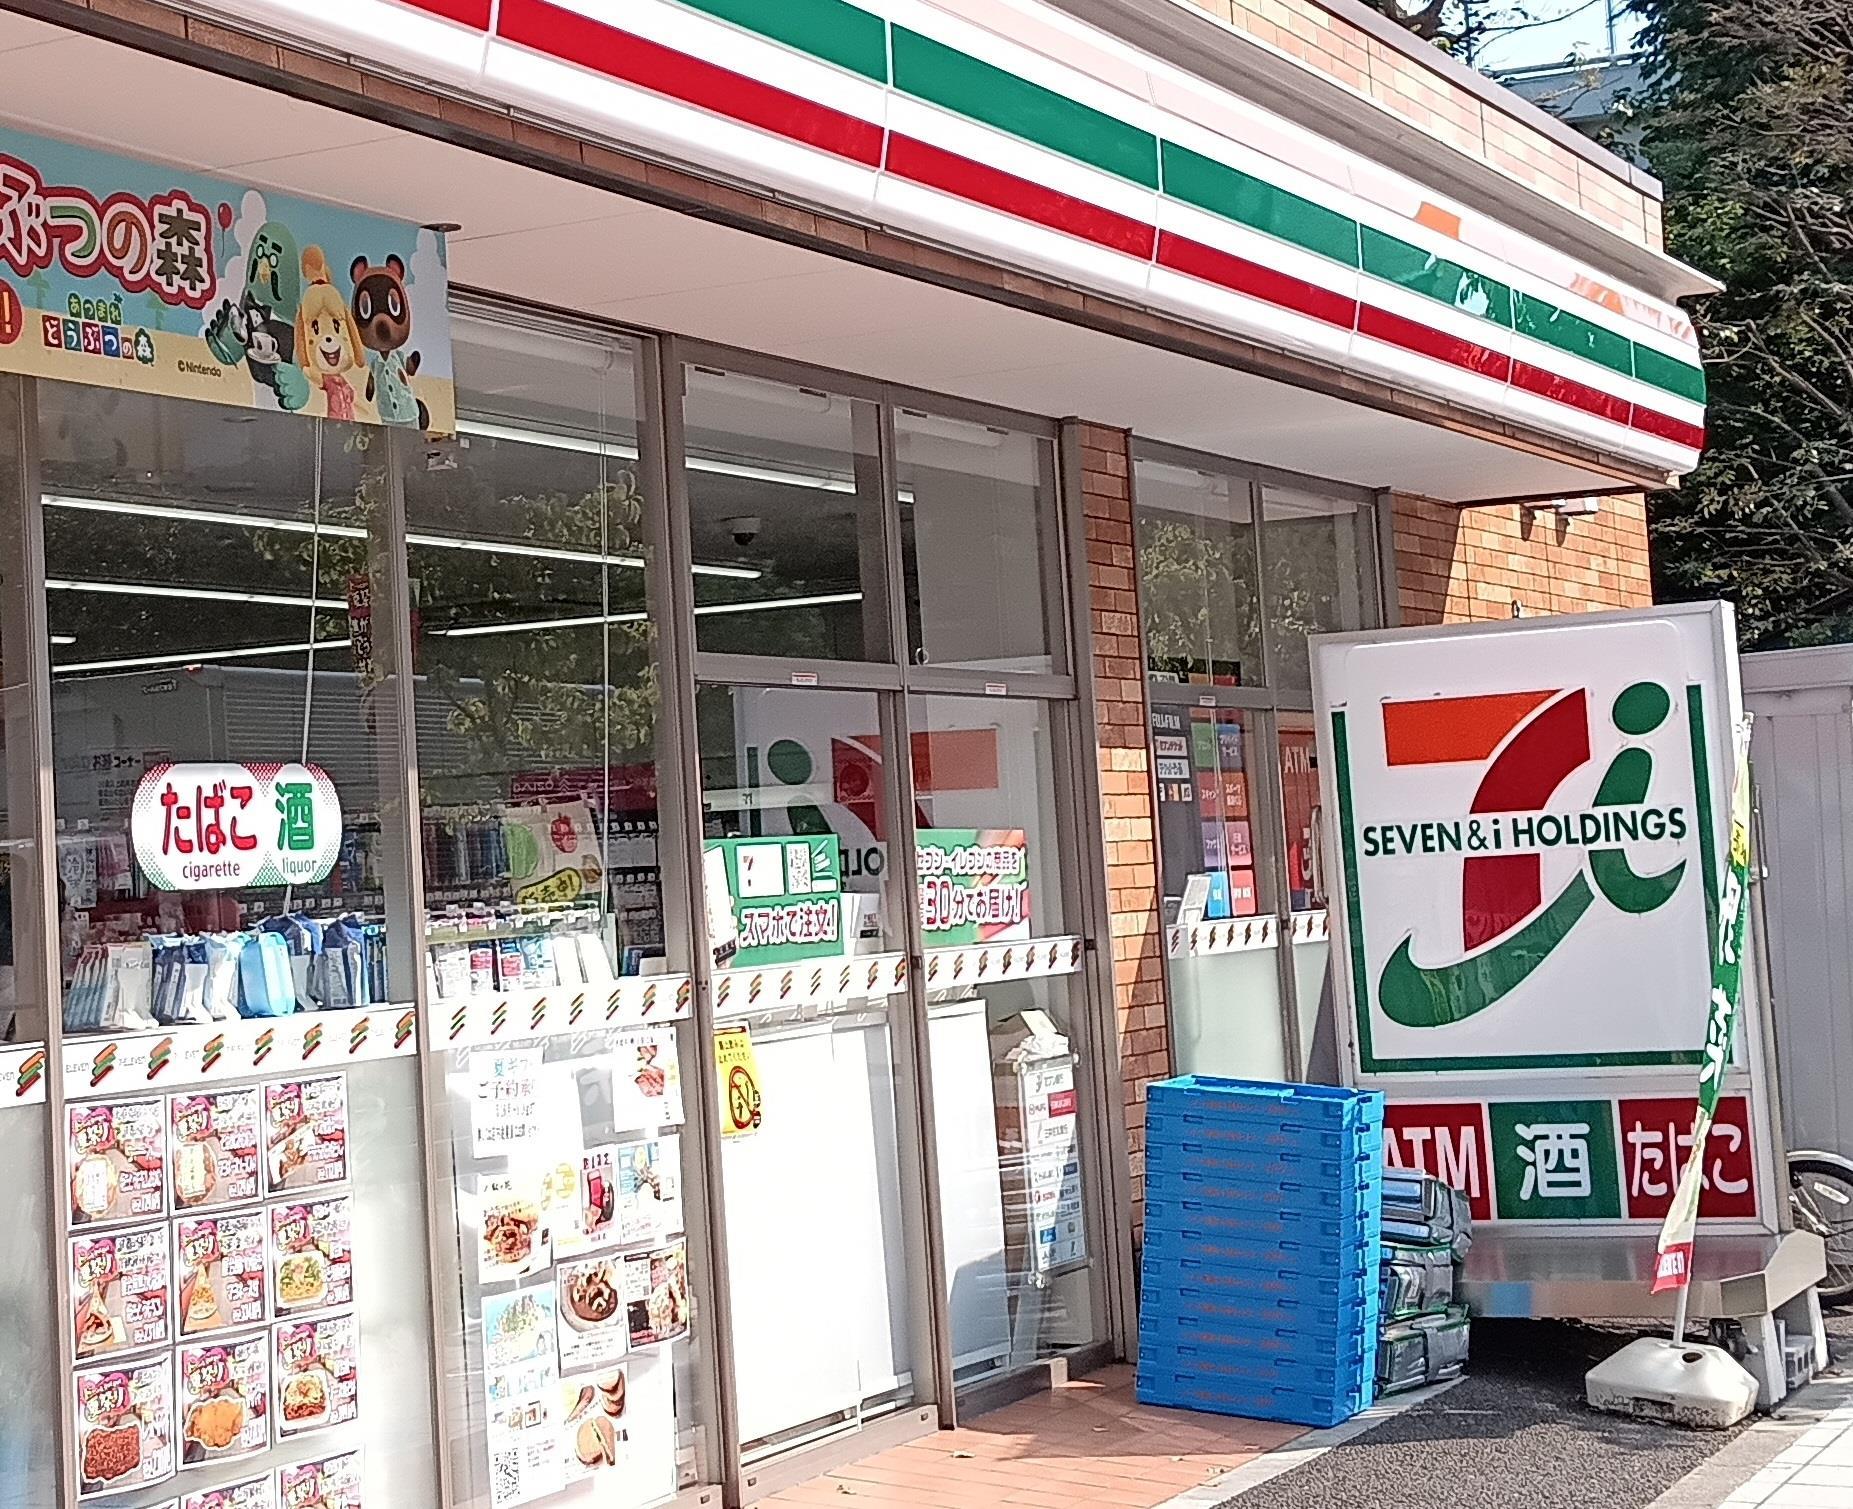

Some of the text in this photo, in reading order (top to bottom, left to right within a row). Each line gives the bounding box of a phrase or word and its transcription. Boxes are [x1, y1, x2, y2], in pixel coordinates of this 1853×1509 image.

[69, 296, 121, 323] あつまれ
[1284, 747, 1310, 774] ATM
[161, 779, 257, 855] たばこ
[275, 782, 315, 851] 酒
[1513, 806, 1687, 848] HOLDINGS
[182, 857, 317, 882] cigarette liquor
[742, 902, 836, 943] スマホで注文!
[1513, 1122, 1592, 1200] 酒
